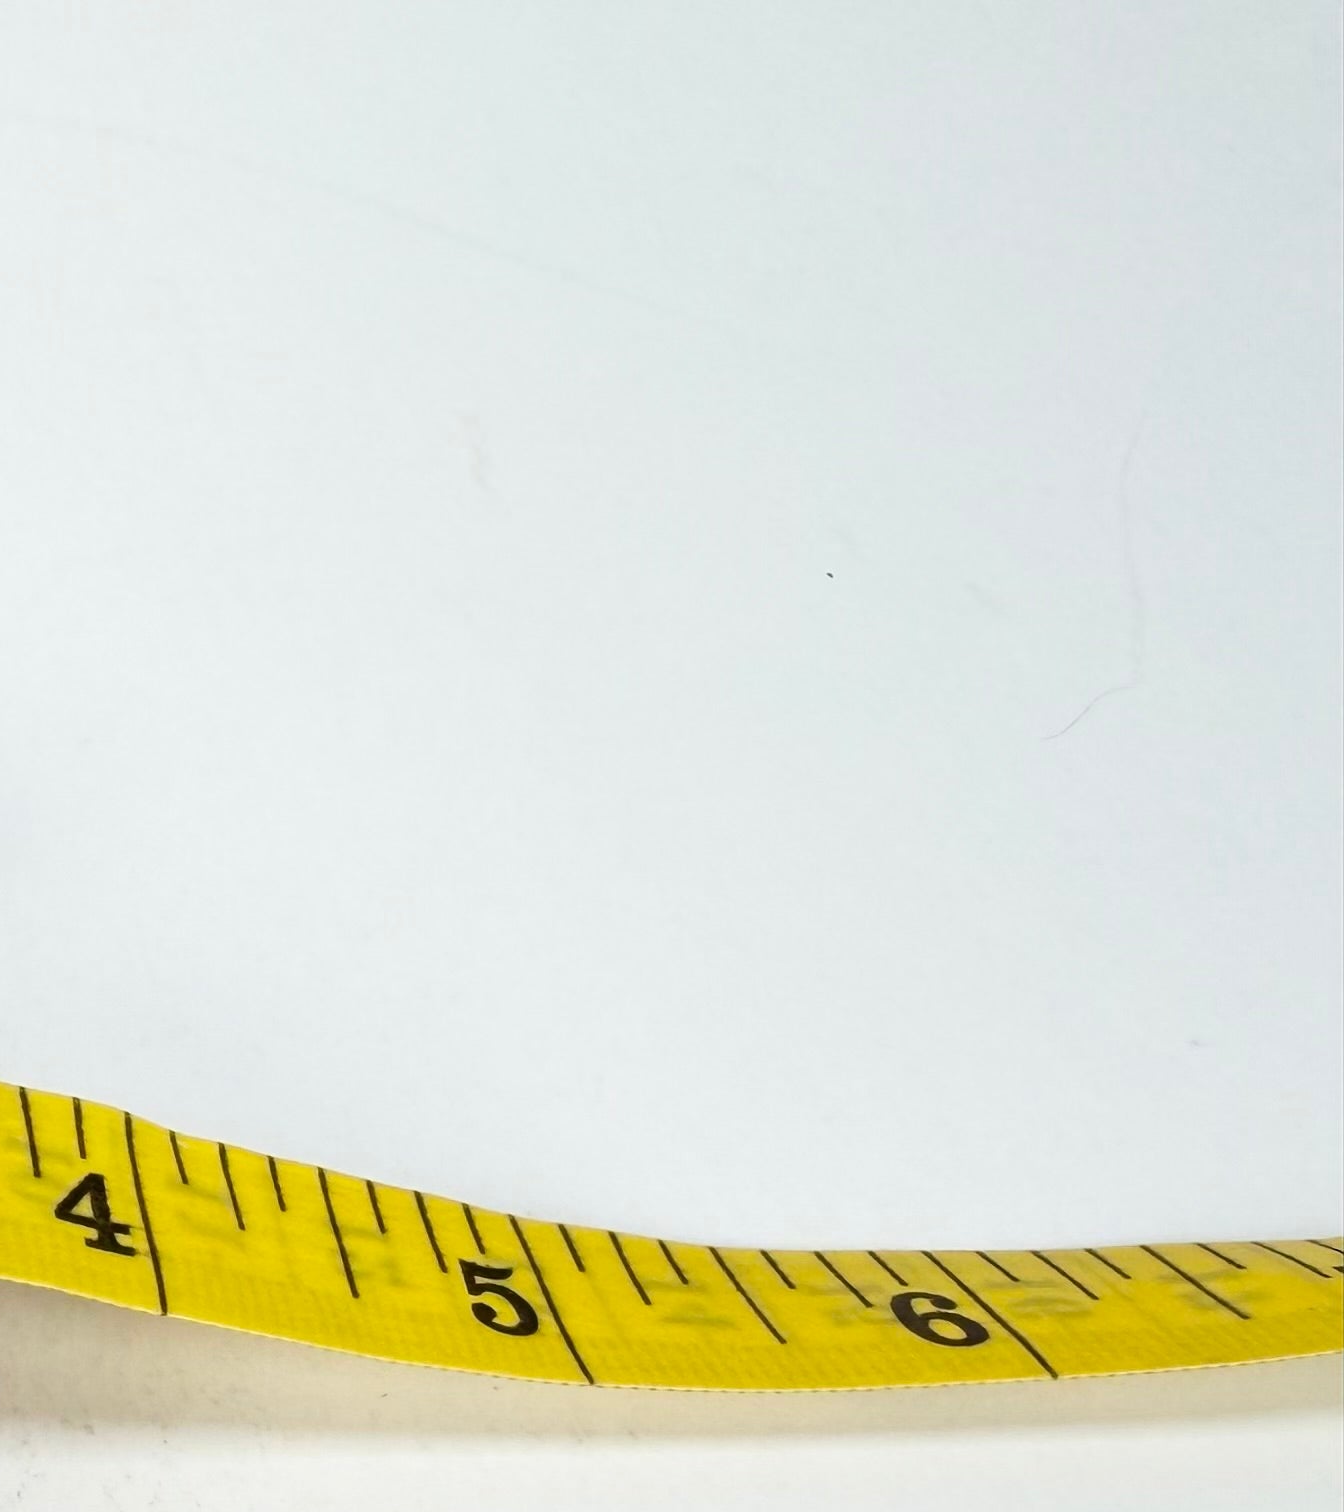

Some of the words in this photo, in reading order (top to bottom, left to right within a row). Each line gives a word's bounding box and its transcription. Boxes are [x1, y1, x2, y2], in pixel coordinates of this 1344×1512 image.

[53, 1172, 136, 1257] 4
[457, 1258, 541, 1337] 5
[888, 1291, 992, 1347] 6
